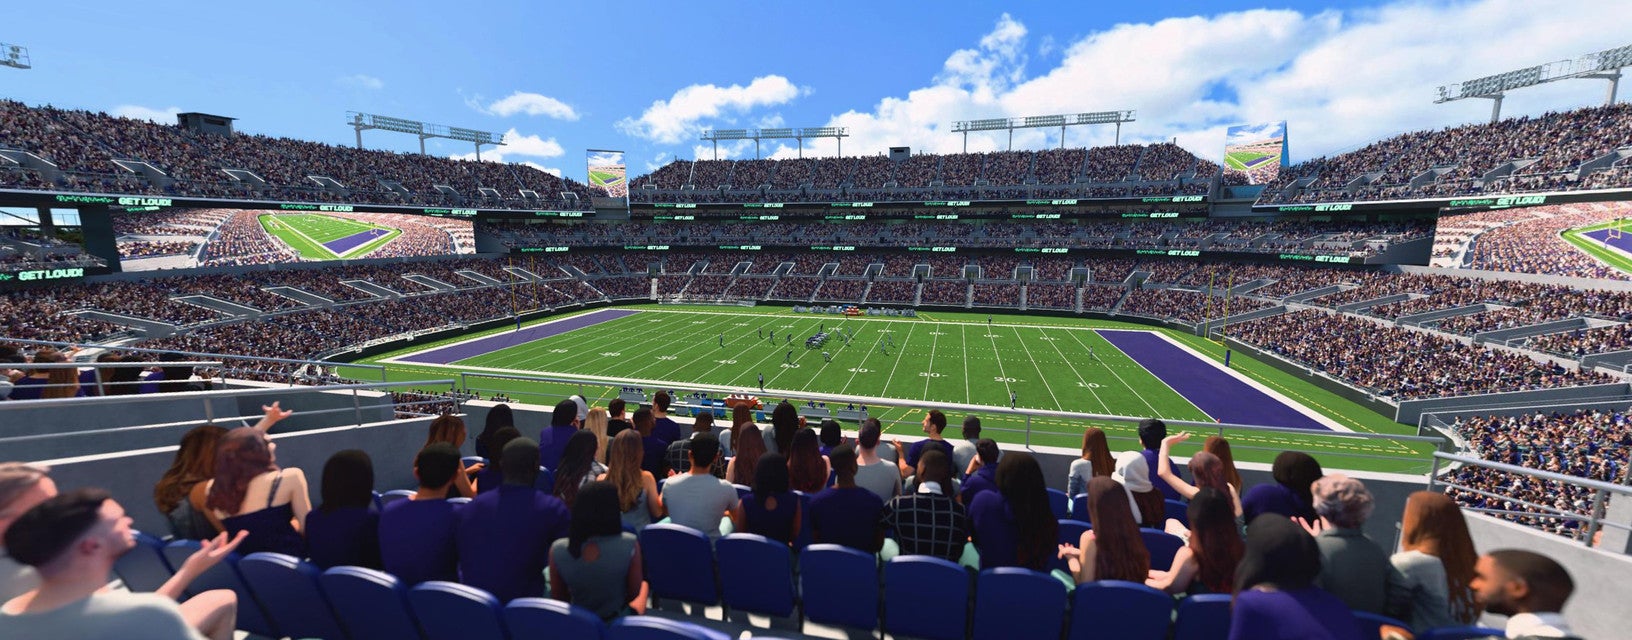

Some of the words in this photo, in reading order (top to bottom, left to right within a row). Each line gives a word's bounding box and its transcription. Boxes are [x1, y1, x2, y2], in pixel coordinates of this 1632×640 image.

[1516, 196, 1546, 204] LOUD!
[18, 270, 45, 280] GET
[45, 268, 84, 279] LOUD!
